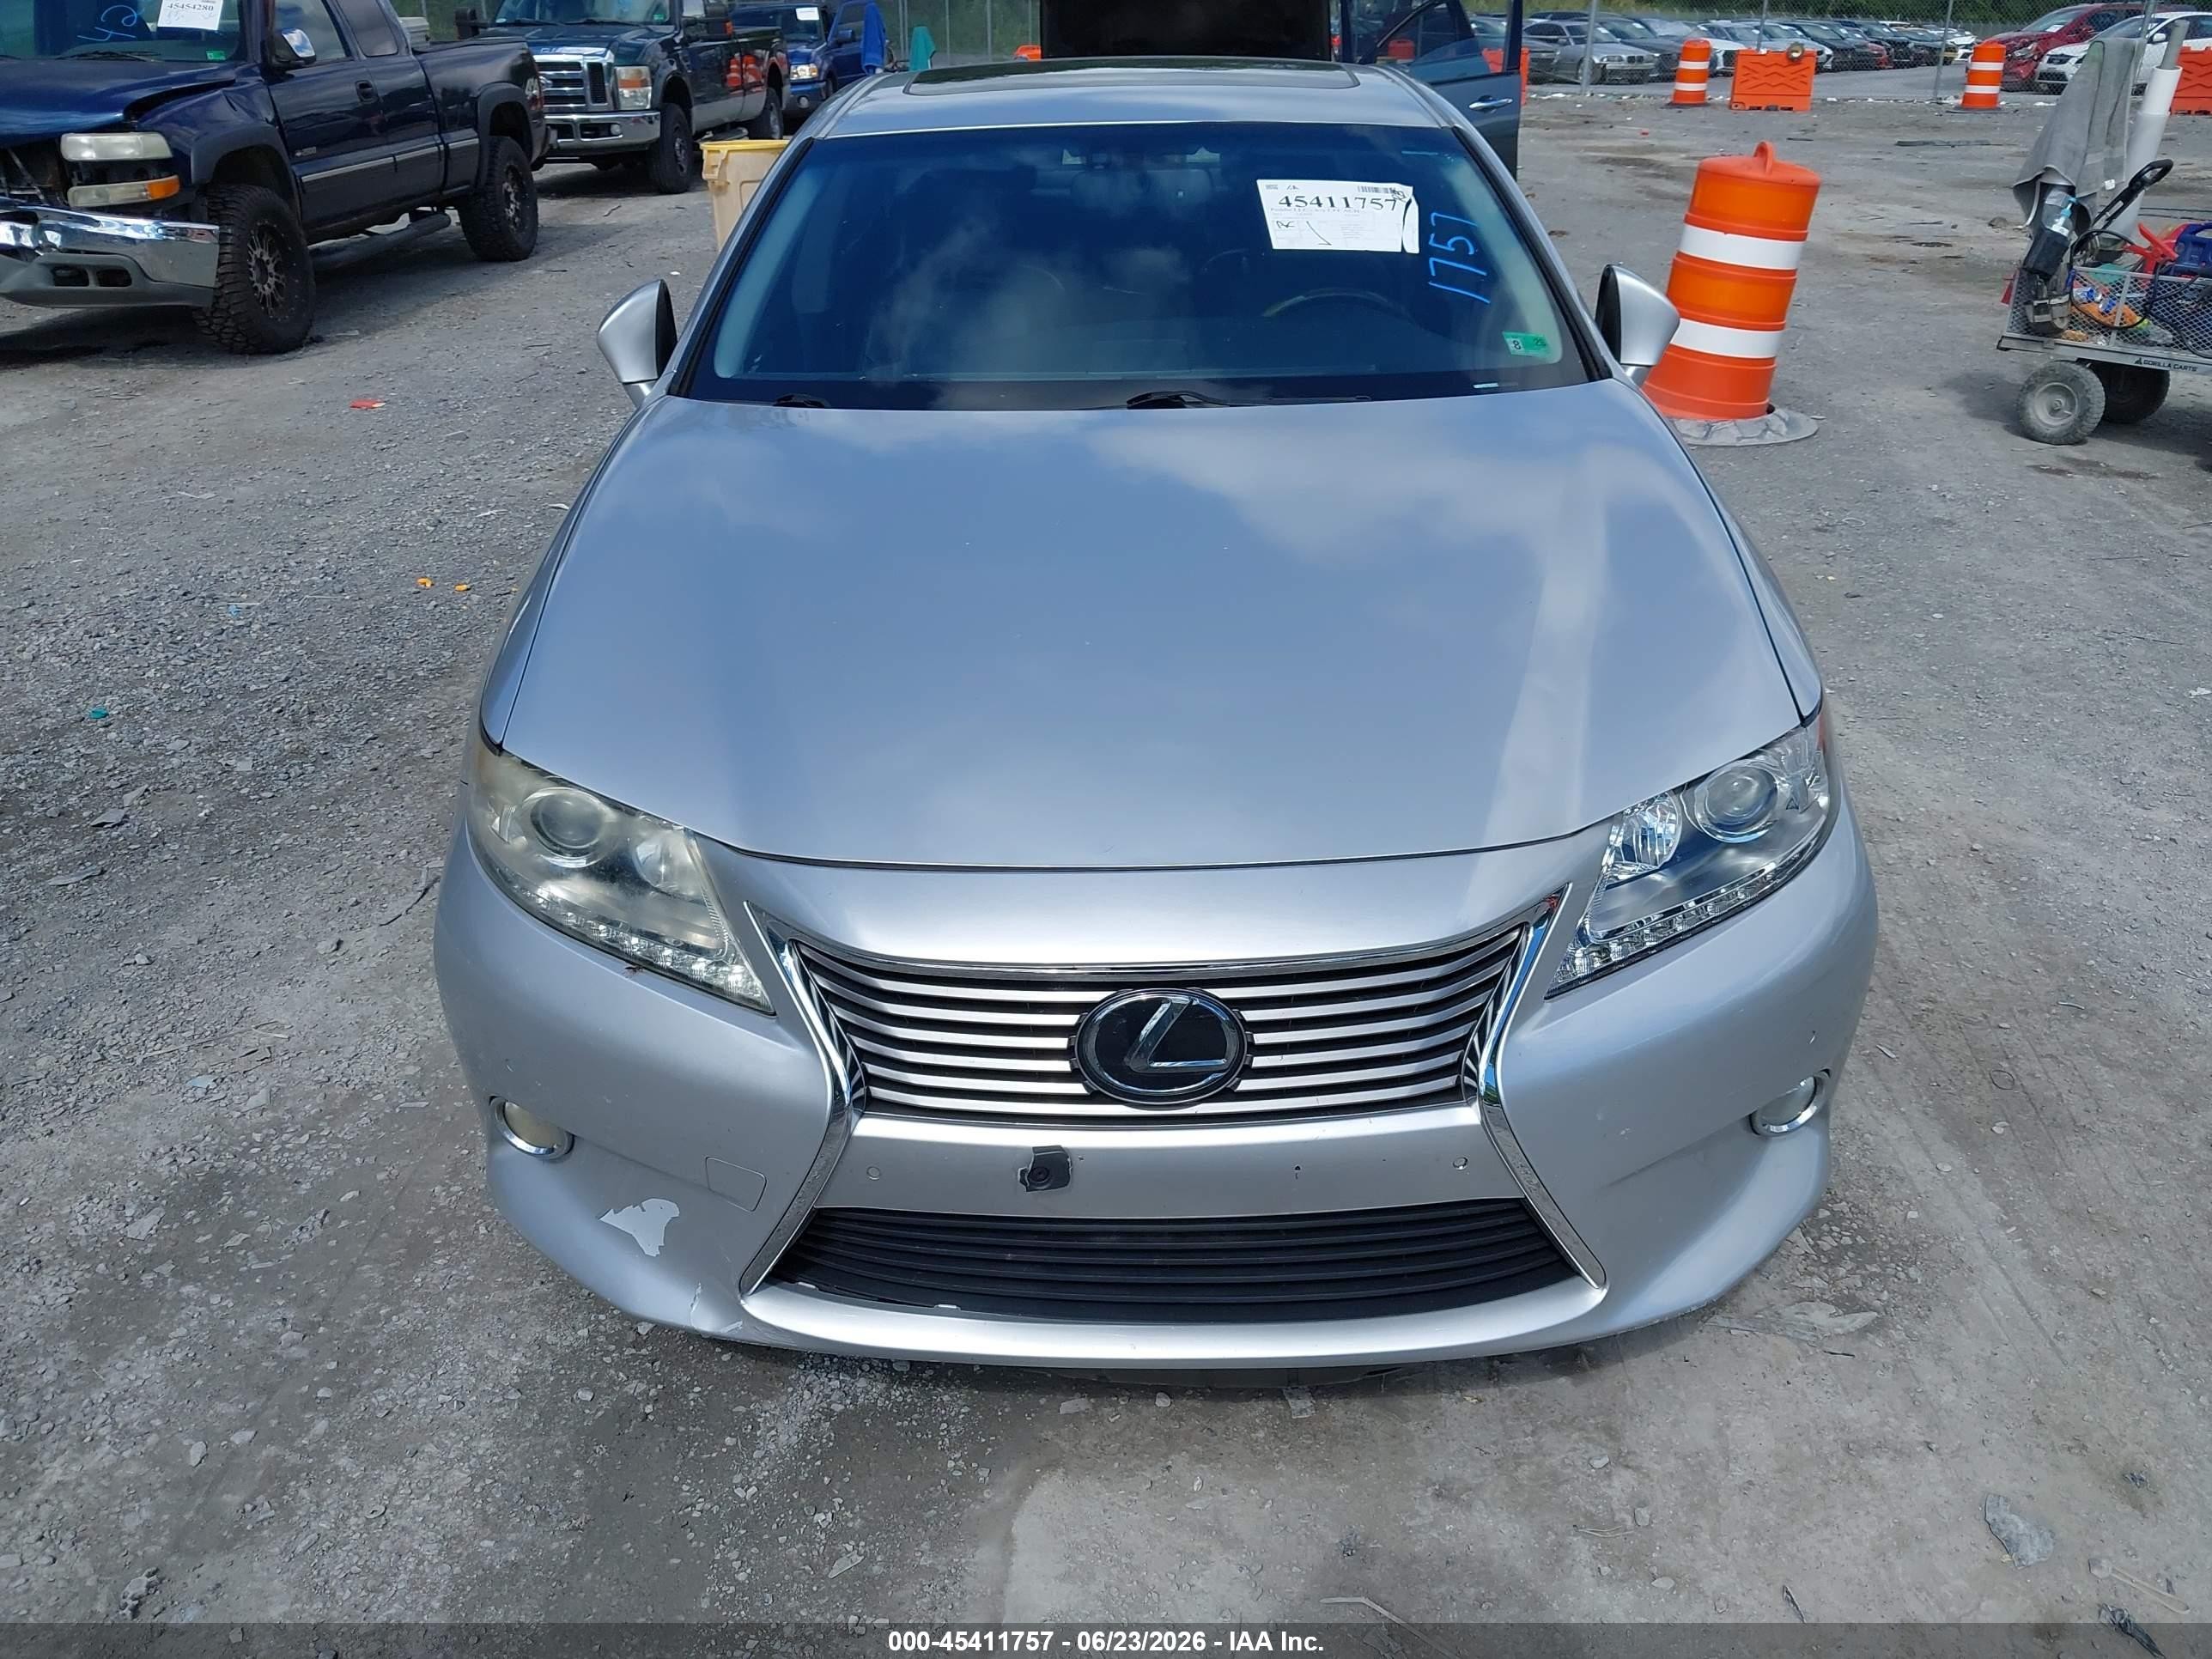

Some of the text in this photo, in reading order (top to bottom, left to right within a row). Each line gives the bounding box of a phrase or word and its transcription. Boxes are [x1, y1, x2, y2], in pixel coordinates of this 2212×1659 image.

[1279, 195, 1397, 211] 45411757
[1428, 211, 1492, 304] 1757
[1512, 339, 1522, 350] 8
